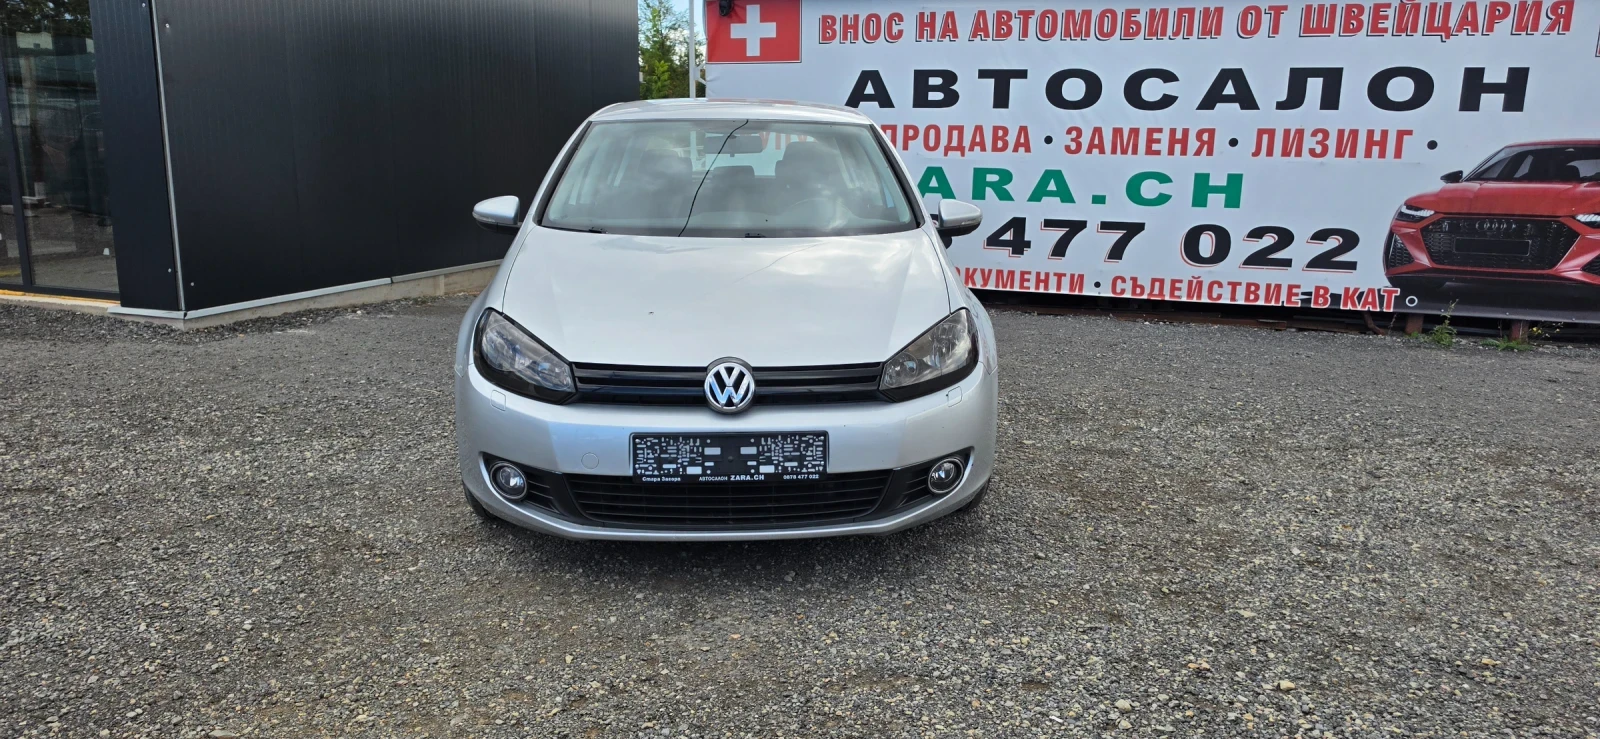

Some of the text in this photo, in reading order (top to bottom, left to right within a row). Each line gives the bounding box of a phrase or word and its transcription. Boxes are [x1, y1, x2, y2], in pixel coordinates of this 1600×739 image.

[818, 0, 1576, 44] ВНОС НА АВТОМОБИЛИ ОТ ШВЕЙЦАРИЯ
[845, 66, 1531, 112] АВТОСАЛОН
[1064, 125, 1217, 157] ЗАМЕНЯ
[1251, 127, 1414, 160] ЛИЗИНГ
[916, 166, 1244, 209] ARA.CH
[983, 216, 1146, 263] 477
[1180, 223, 1361, 273] 022
[955, 266, 1400, 312] КУМЕНТИ СЪДЕЙСТВИЕ В КАТ
[706, 364, 754, 409] VW
